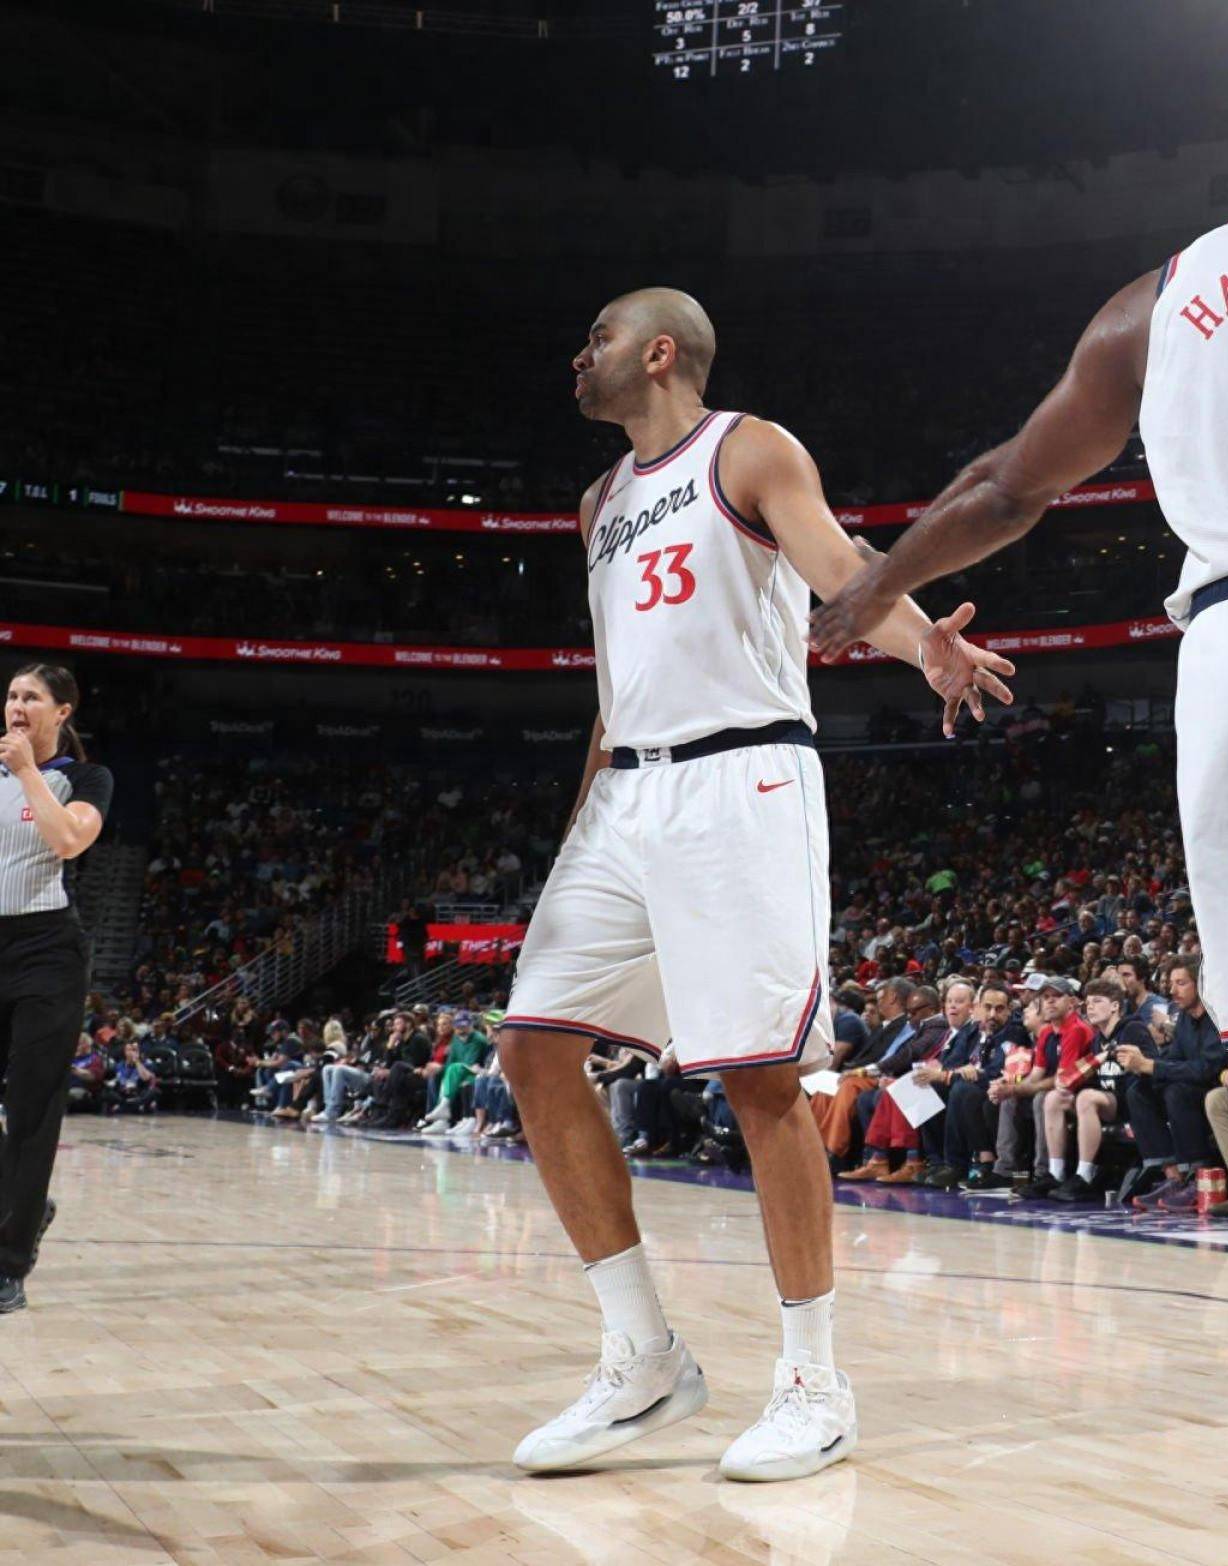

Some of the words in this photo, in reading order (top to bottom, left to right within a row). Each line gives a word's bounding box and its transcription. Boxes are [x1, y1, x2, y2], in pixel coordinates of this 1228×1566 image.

[804, 52, 814, 65] 2
[673, 65, 690, 78] 12
[740, 59, 750, 72] 2
[588, 478, 699, 573] Clippers
[634, 543, 697, 612] 33
